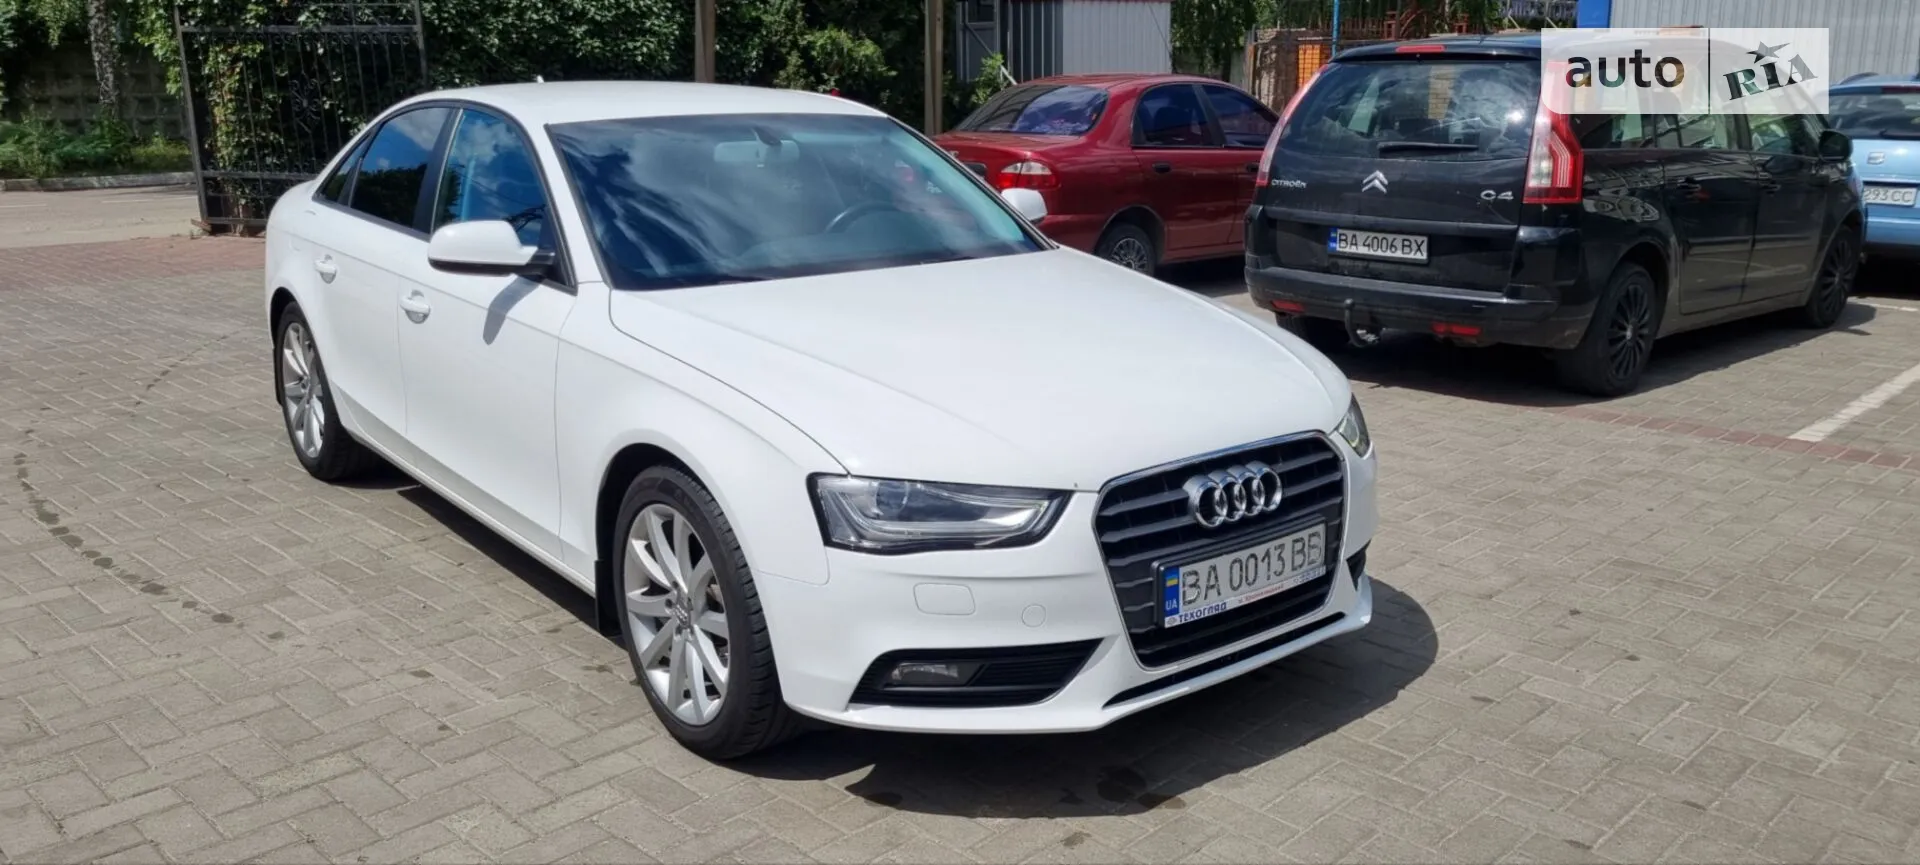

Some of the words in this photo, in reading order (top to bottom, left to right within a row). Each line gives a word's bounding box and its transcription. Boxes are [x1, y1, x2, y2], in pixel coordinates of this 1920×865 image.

[1480, 190, 1514, 200] C4
[1339, 233, 1358, 250] BA
[1363, 235, 1398, 254] 4006
[1402, 238, 1425, 256] BX
[1182, 564, 1221, 606] BA
[1229, 543, 1286, 592] 0013
[1165, 598, 1178, 611] UA
